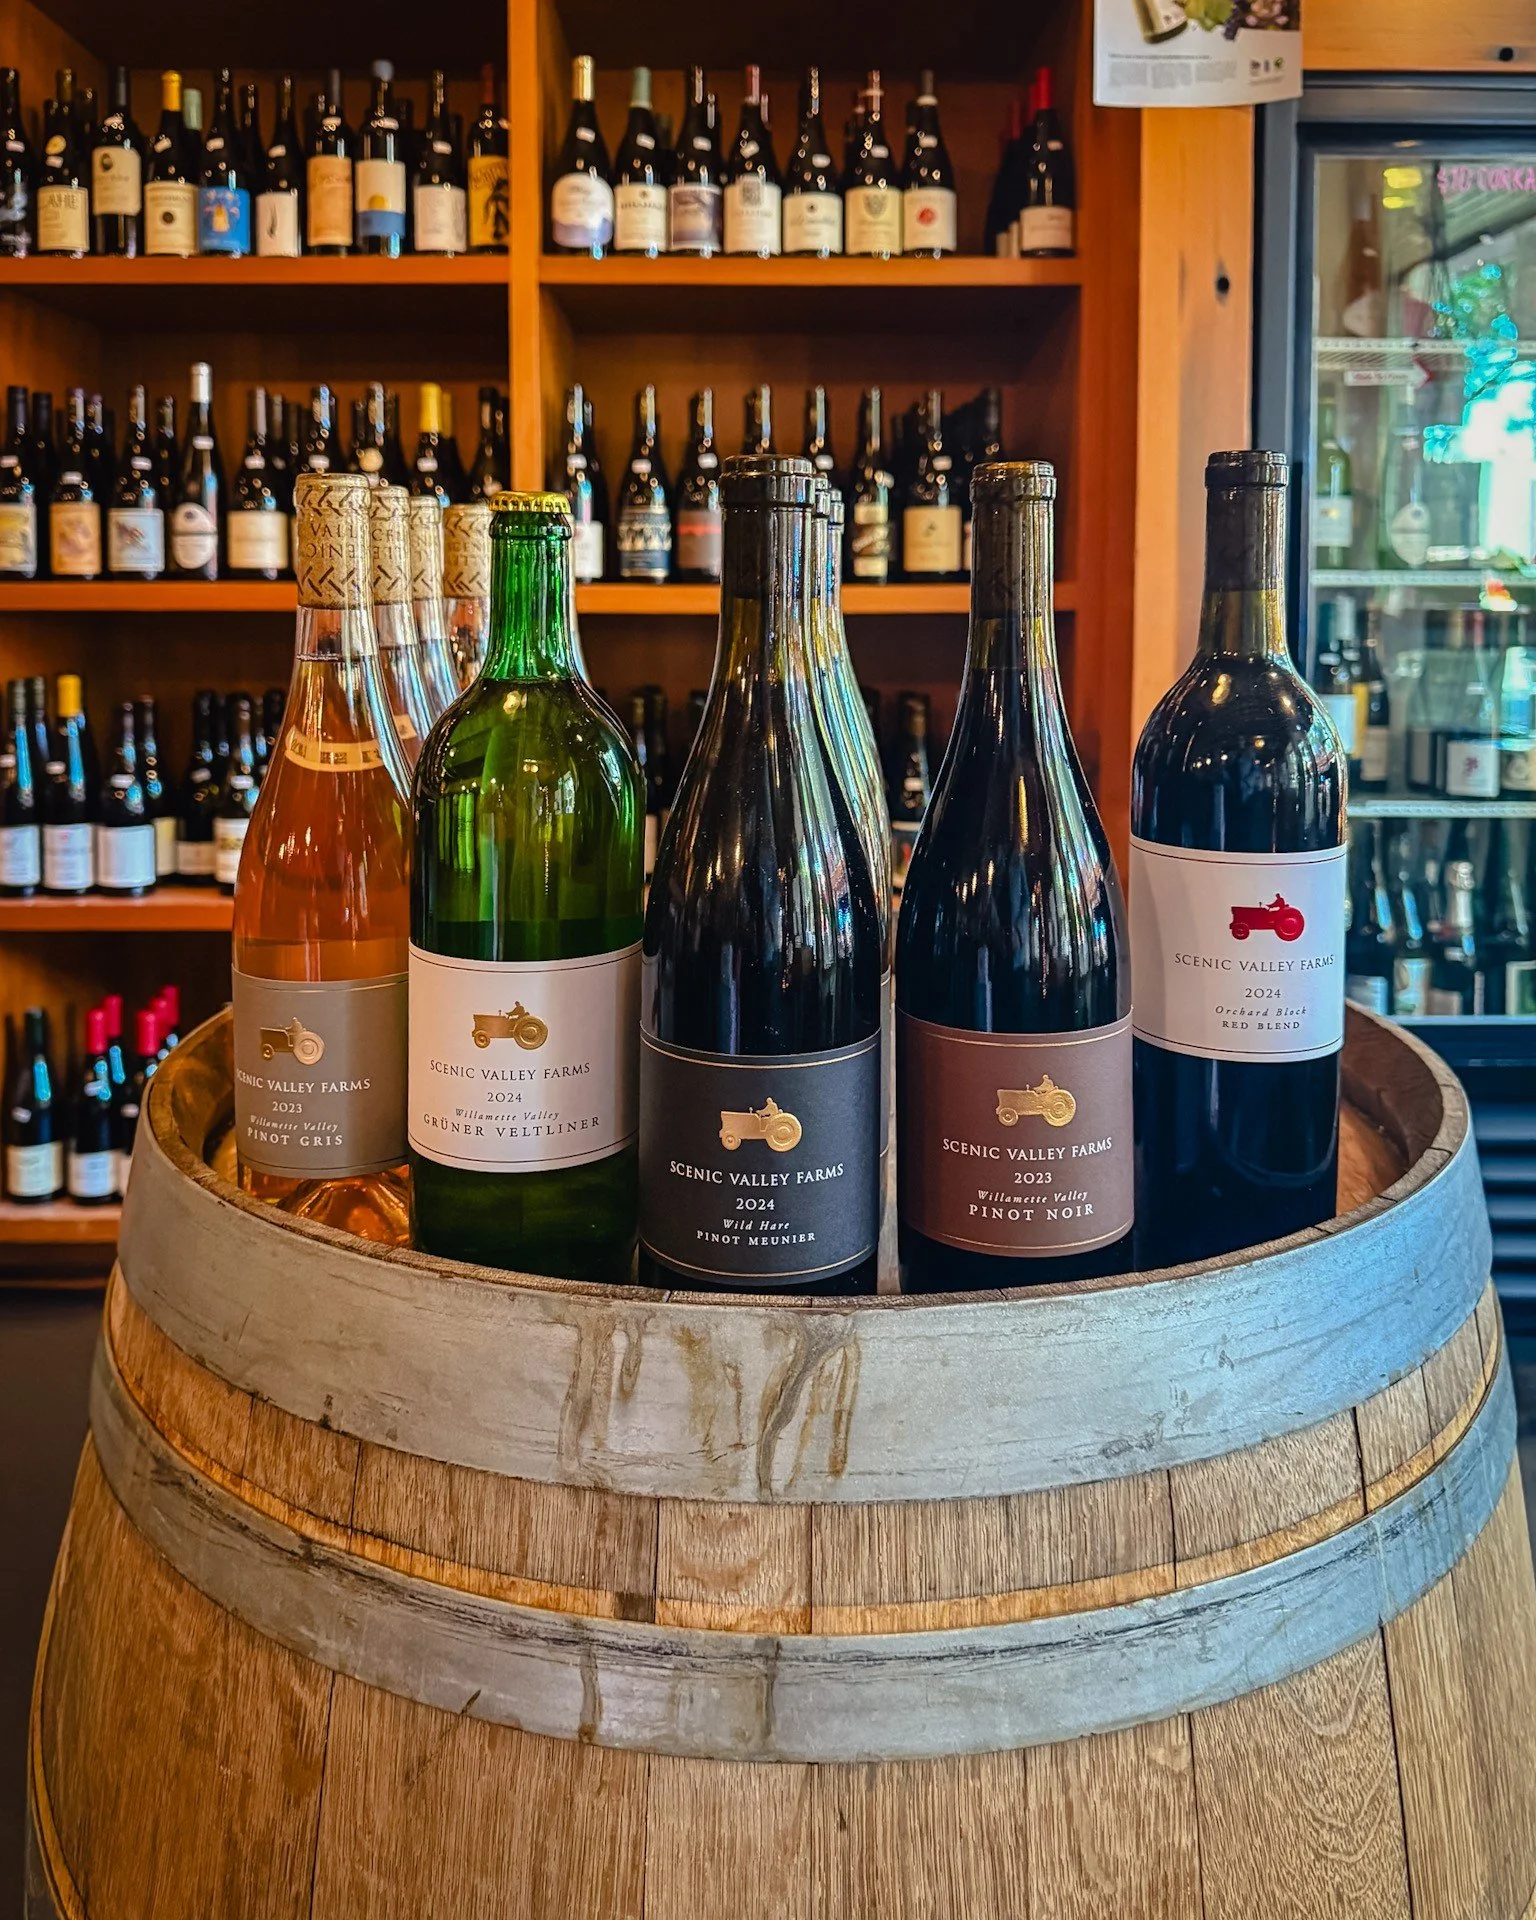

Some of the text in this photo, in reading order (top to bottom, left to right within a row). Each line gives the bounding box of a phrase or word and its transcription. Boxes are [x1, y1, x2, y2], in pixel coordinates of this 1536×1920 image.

[1174, 953, 1334, 972] SCENIC VALLEY FARMS
[1245, 988, 1282, 999] 2024
[1215, 1005, 1307, 1017] Orchard Block
[1222, 1020, 1300, 1030] RED BLEND
[430, 1059, 591, 1081] SCENIC VALLEY FARMS
[236, 1067, 371, 1094] SCENIC VALLEY FARMS
[487, 1092, 523, 1103] 2024
[272, 1101, 303, 1114] 2023
[455, 1108, 560, 1121] Willamette Valley
[250, 1114, 339, 1133] Willamette Valley
[423, 1113, 601, 1138] GRÜNER VELTLINER
[247, 1126, 344, 1147] PINOT GRIS
[943, 1136, 1112, 1161] SCENIC VALLEY FARMS
[670, 1160, 845, 1187] SCENIC VALLEY FARMS
[1014, 1172, 1053, 1184] 2023
[977, 1189, 1088, 1203] Willamette Valley
[735, 1198, 775, 1211] 2024
[968, 1203, 1094, 1221] PINOT NOIR
[722, 1218, 790, 1231] Wild Hare
[696, 1230, 816, 1246] PINOT MEUNIER
